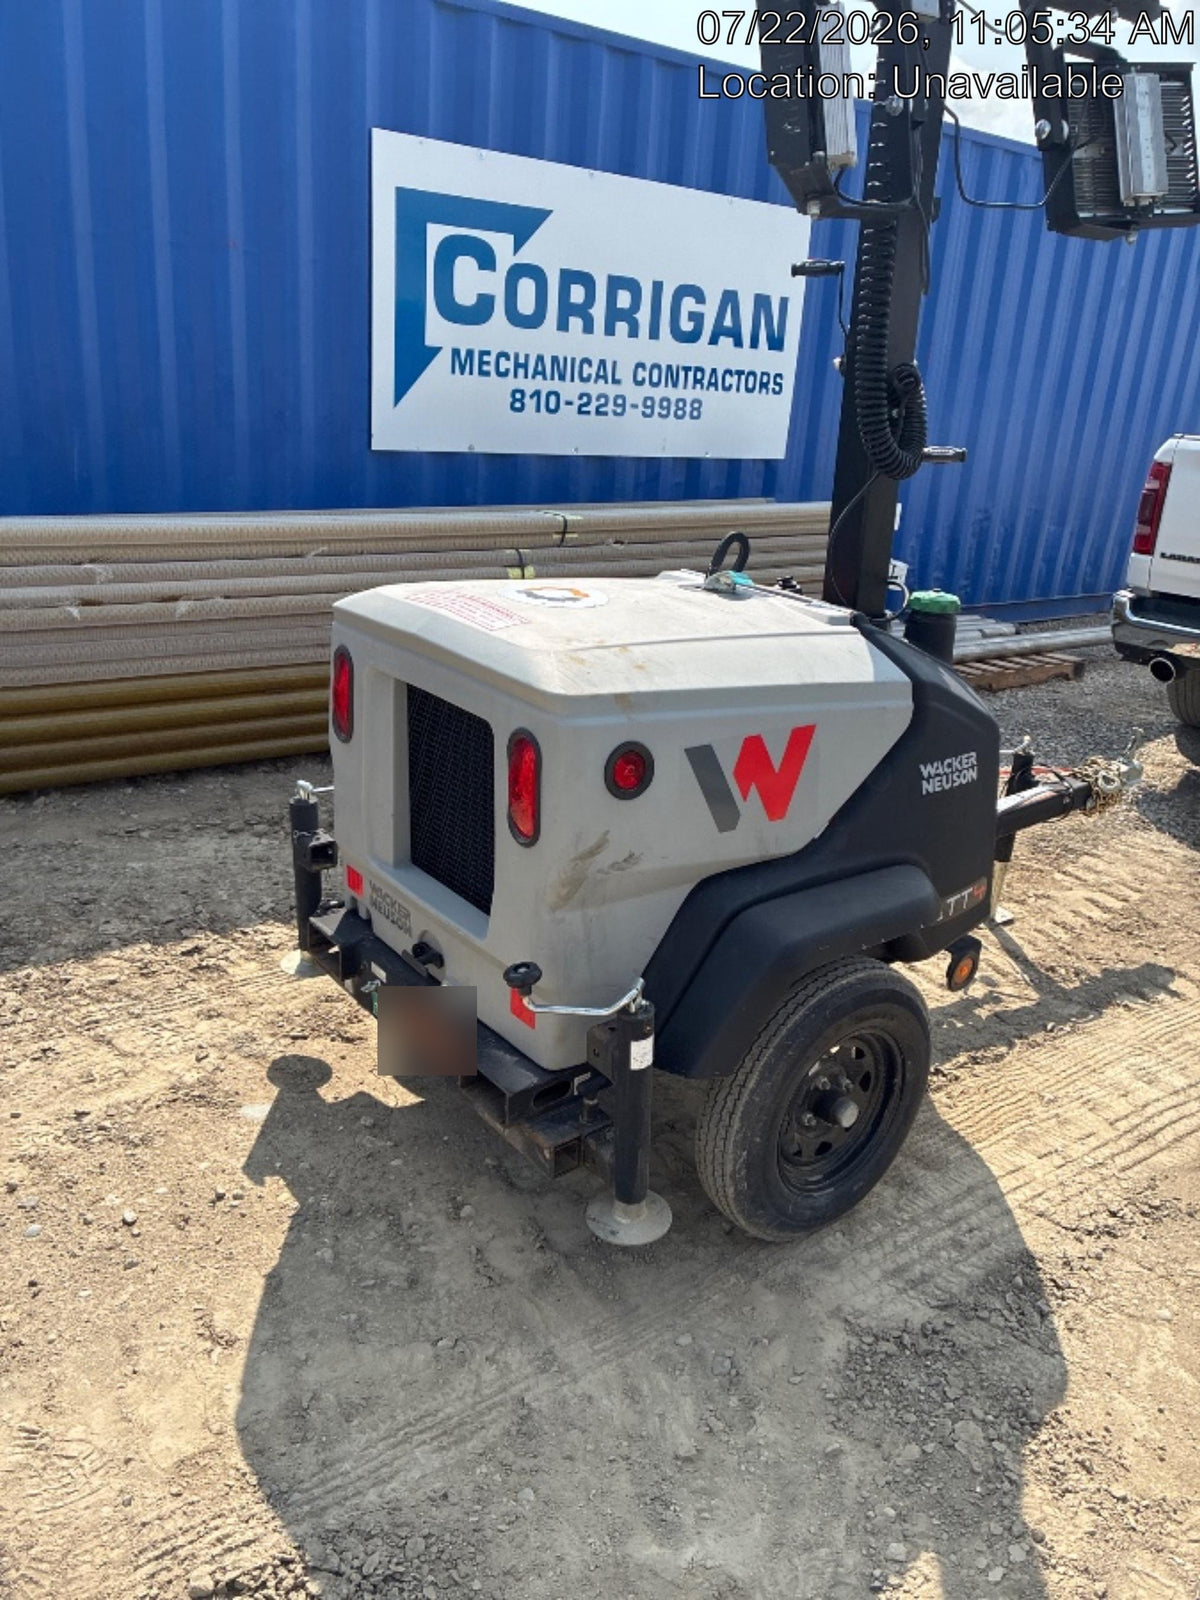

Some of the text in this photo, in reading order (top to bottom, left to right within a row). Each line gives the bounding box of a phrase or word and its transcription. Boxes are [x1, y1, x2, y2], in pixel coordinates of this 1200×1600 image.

[433, 233, 790, 353] CORRIGAN
[450, 347, 784, 396] MECHANICAL CONTRACTORS
[509, 388, 704, 421] 810-229-9988
[919, 751, 978, 780] WACKER
[921, 766, 979, 796] NEUSON
